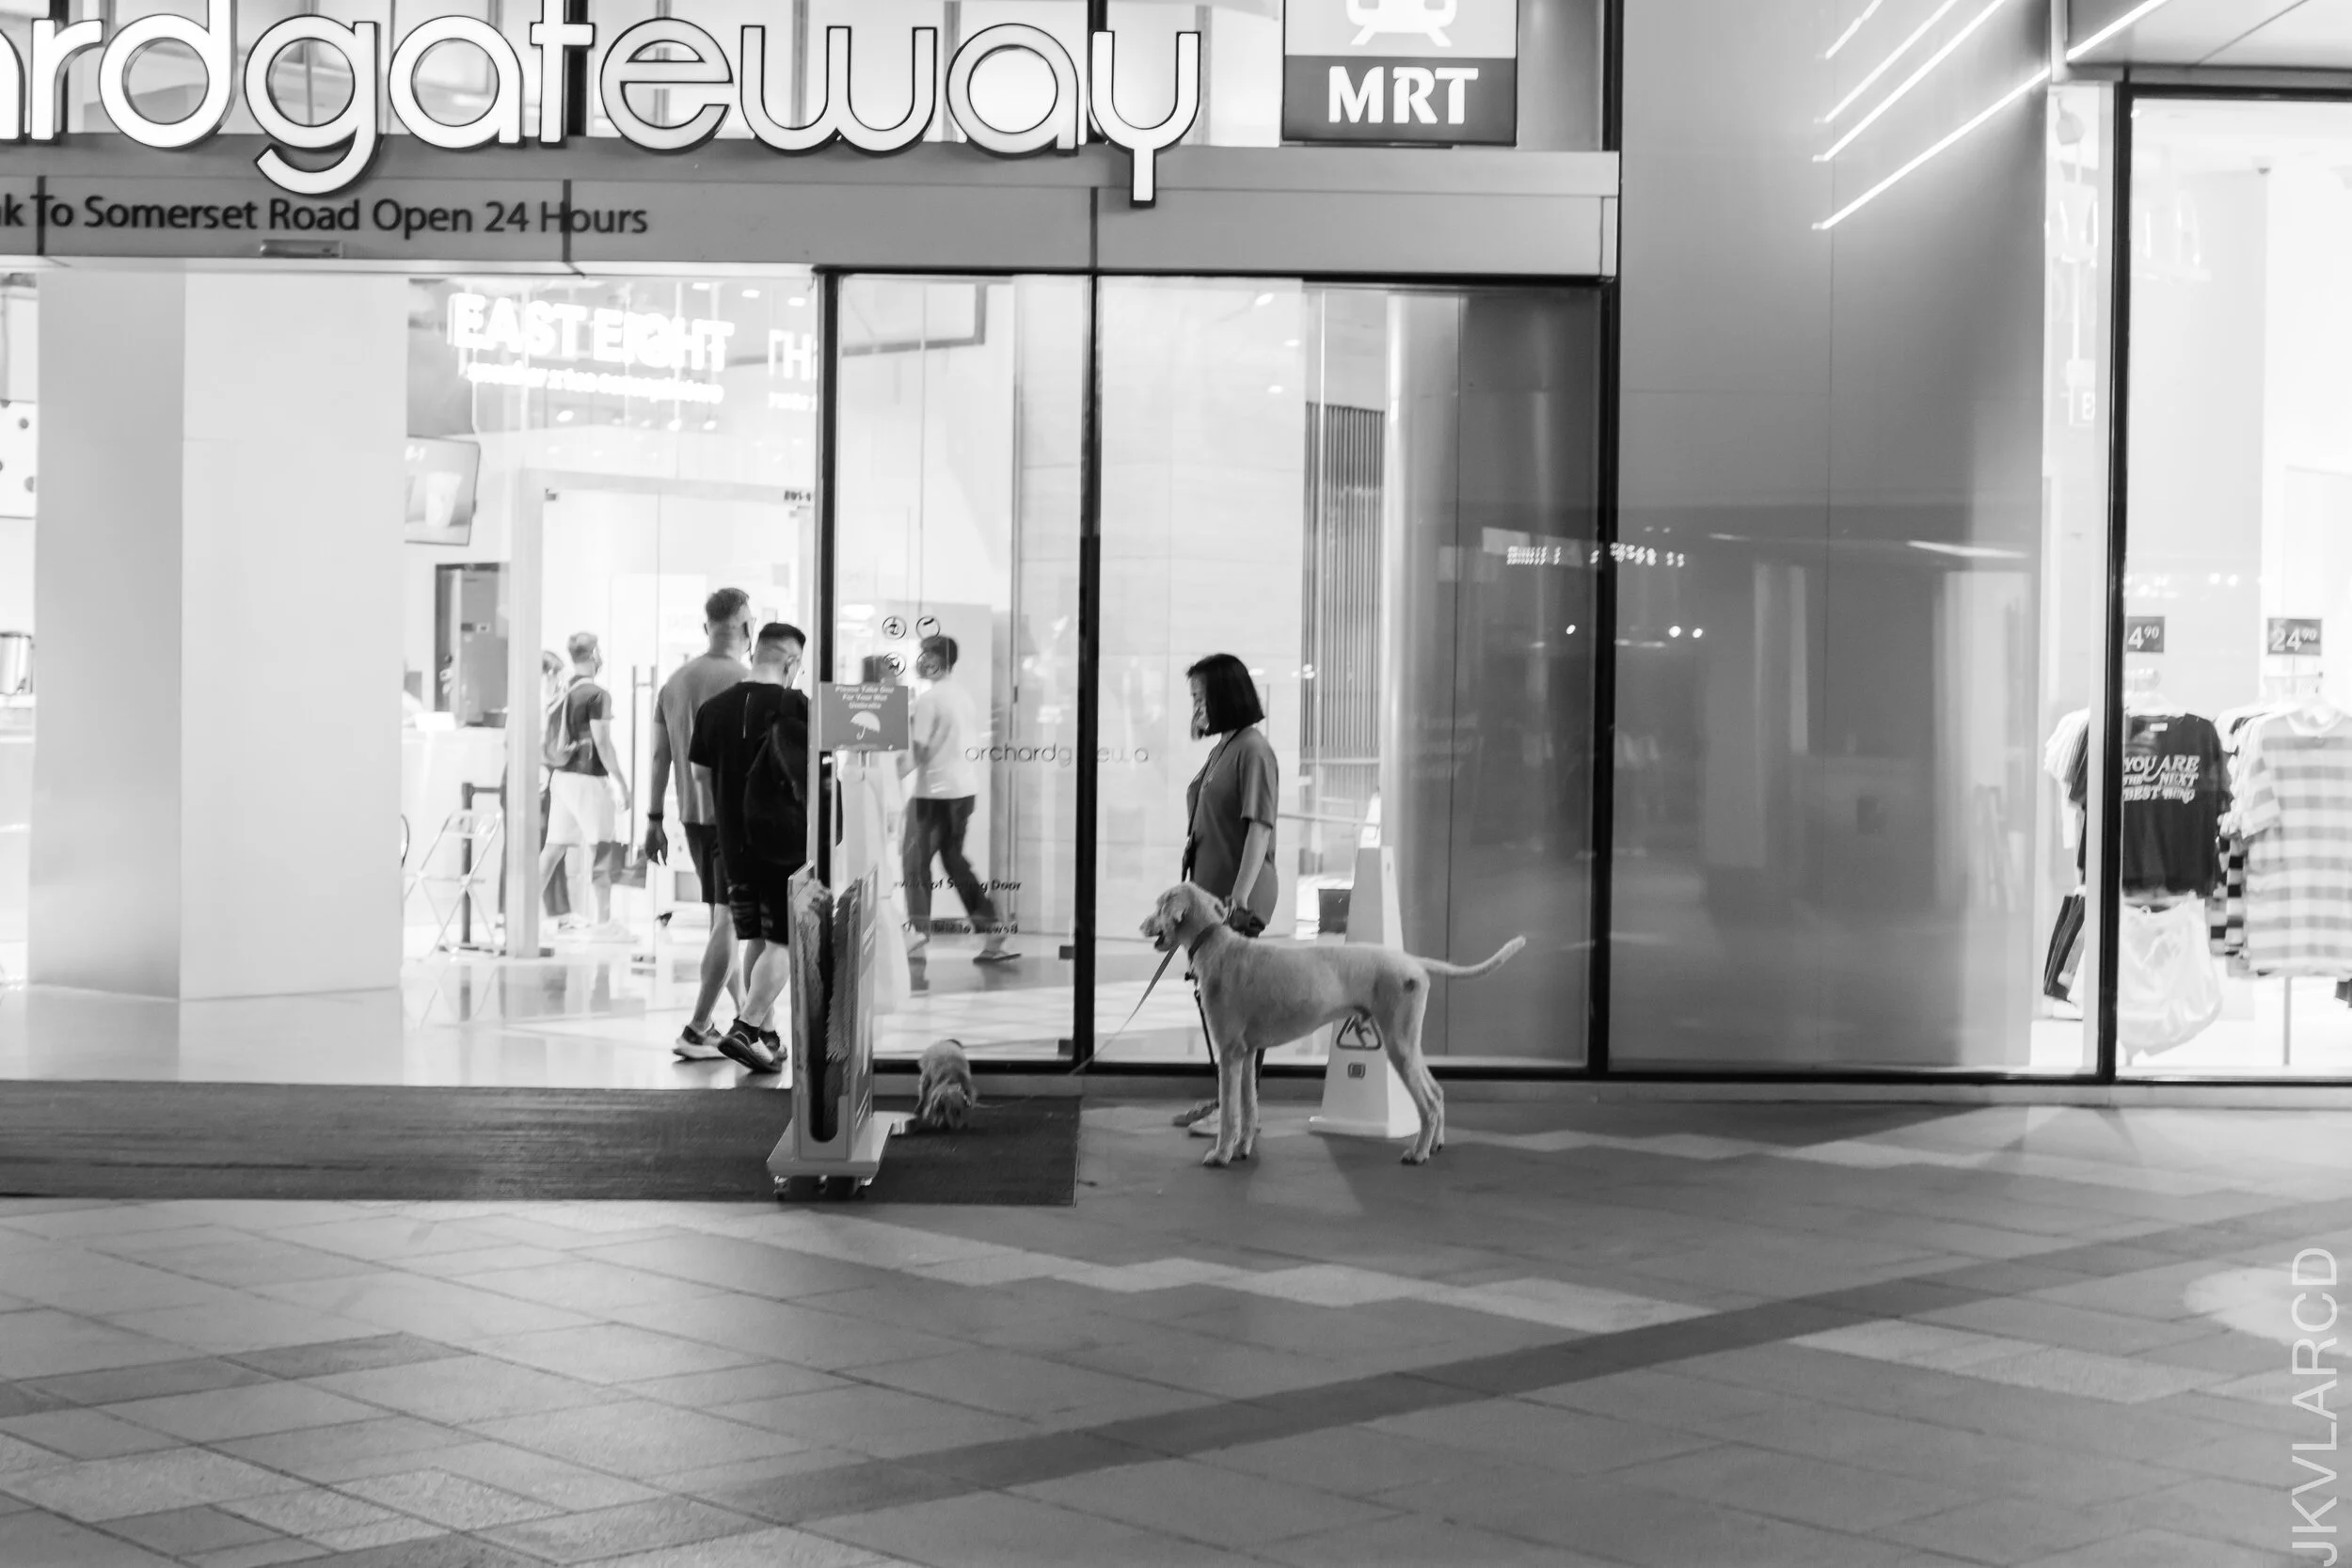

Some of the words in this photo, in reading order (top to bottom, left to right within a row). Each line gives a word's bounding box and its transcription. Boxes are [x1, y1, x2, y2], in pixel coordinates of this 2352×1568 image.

[0, 0, 1201, 209] rdgateway
[1328, 66, 1479, 124] MRT
[0, 194, 25, 227] k
[30, 195, 74, 227] To
[84, 196, 259, 230] Somerset
[269, 197, 360, 230] Road
[372, 198, 472, 240] Open
[484, 200, 530, 232] 24
[540, 200, 649, 234] Hours
[449, 293, 588, 357] EAST
[593, 308, 736, 372] EIGHT
[2161, 754, 2200, 772] ARE
